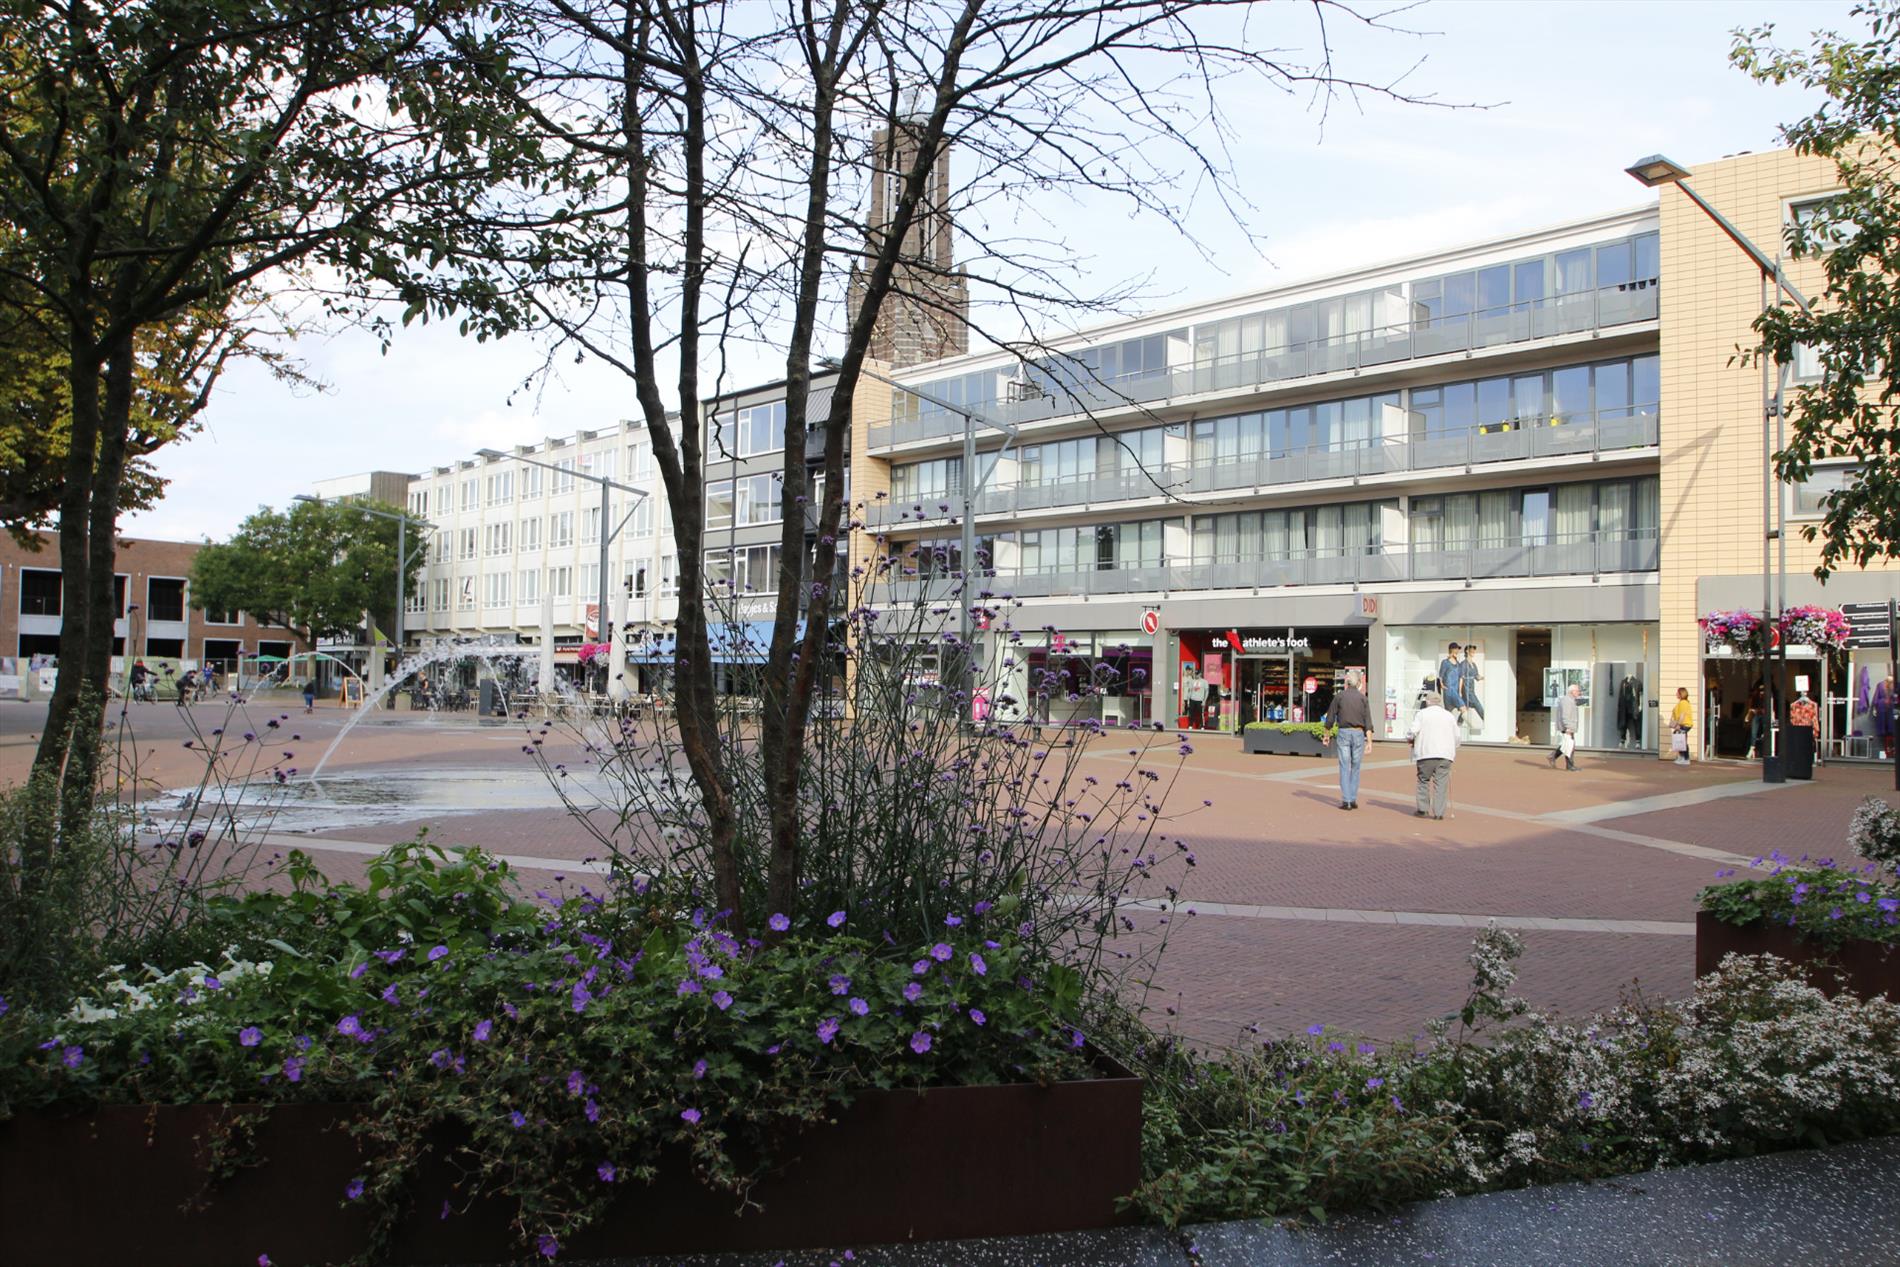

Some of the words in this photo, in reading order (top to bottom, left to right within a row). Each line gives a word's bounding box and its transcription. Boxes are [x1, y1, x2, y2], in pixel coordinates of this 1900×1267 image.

[1212, 638, 1228, 647] the
[1242, 637, 1285, 647] athlete's
[1286, 637, 1308, 647] foot
